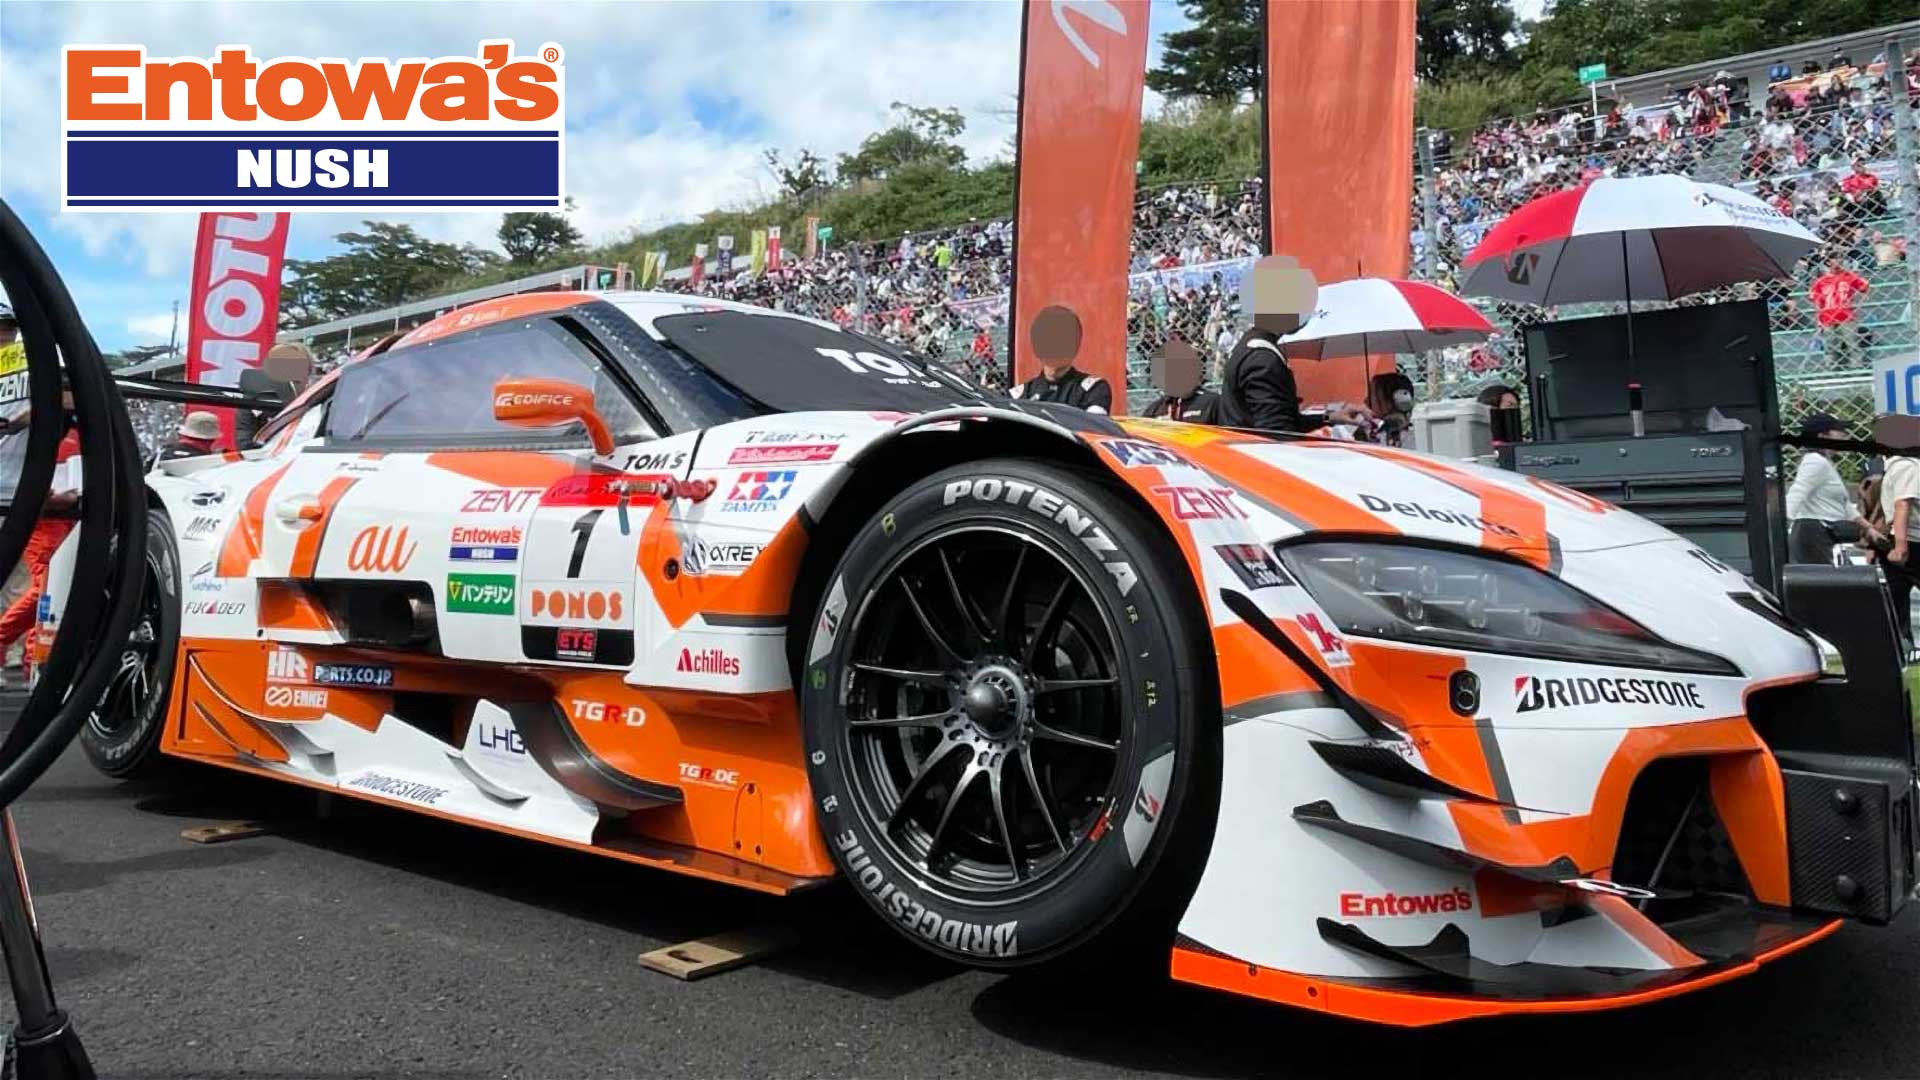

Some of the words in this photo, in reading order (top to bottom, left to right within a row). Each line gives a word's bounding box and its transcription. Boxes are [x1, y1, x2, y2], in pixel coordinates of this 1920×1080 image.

[199, 212, 277, 389] MOTU
[461, 490, 542, 513] ZENT
[1152, 486, 1250, 520] ZENT
[347, 525, 418, 573] au
[566, 509, 605, 579] 1
[943, 479, 1138, 598] POTENZA
[531, 589, 623, 621] PONOS
[676, 648, 740, 676] Achilles
[1514, 675, 1705, 714] BRIDGESTONE
[834, 829, 1018, 957] BRIDGESTONE
[1340, 887, 1472, 916] Entowa's
